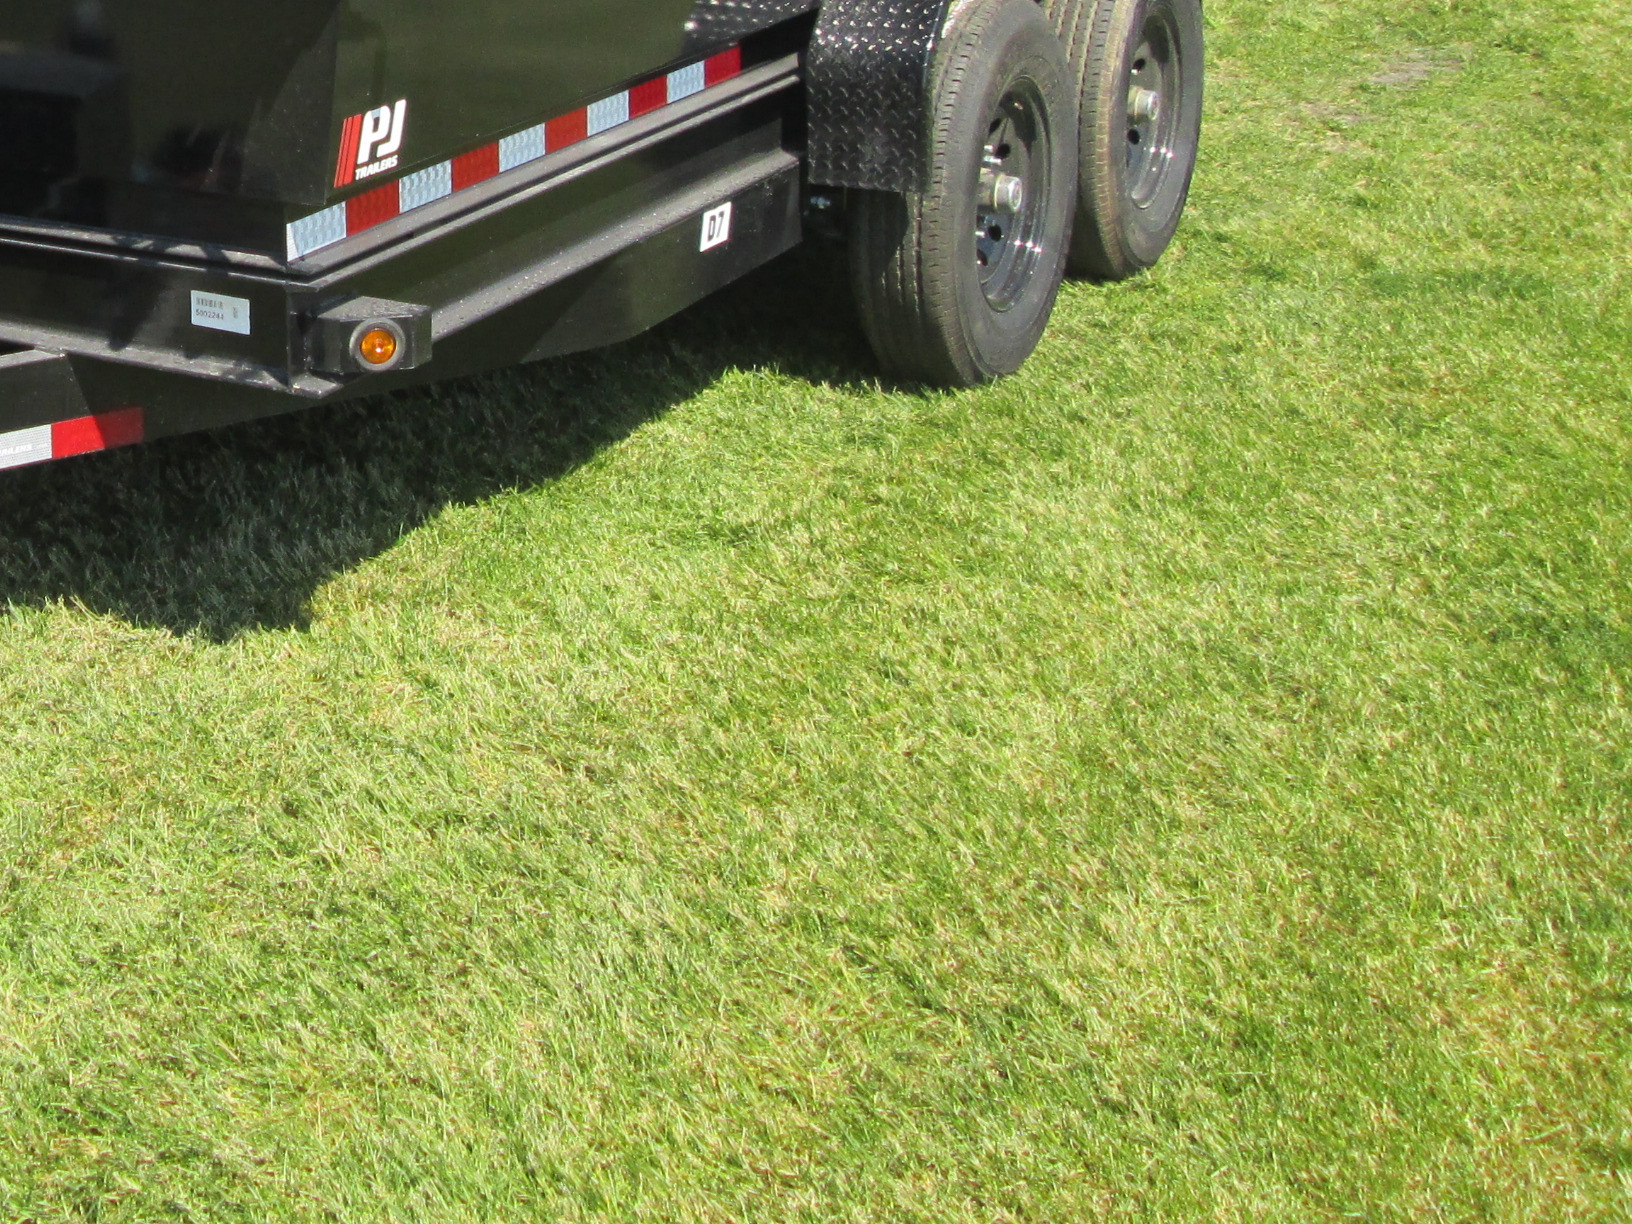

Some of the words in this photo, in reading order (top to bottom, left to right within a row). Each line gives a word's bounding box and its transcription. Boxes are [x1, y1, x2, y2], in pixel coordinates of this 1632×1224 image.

[357, 99, 406, 165] PJ
[355, 155, 399, 180] TRAILERS
[707, 210, 725, 242] D7
